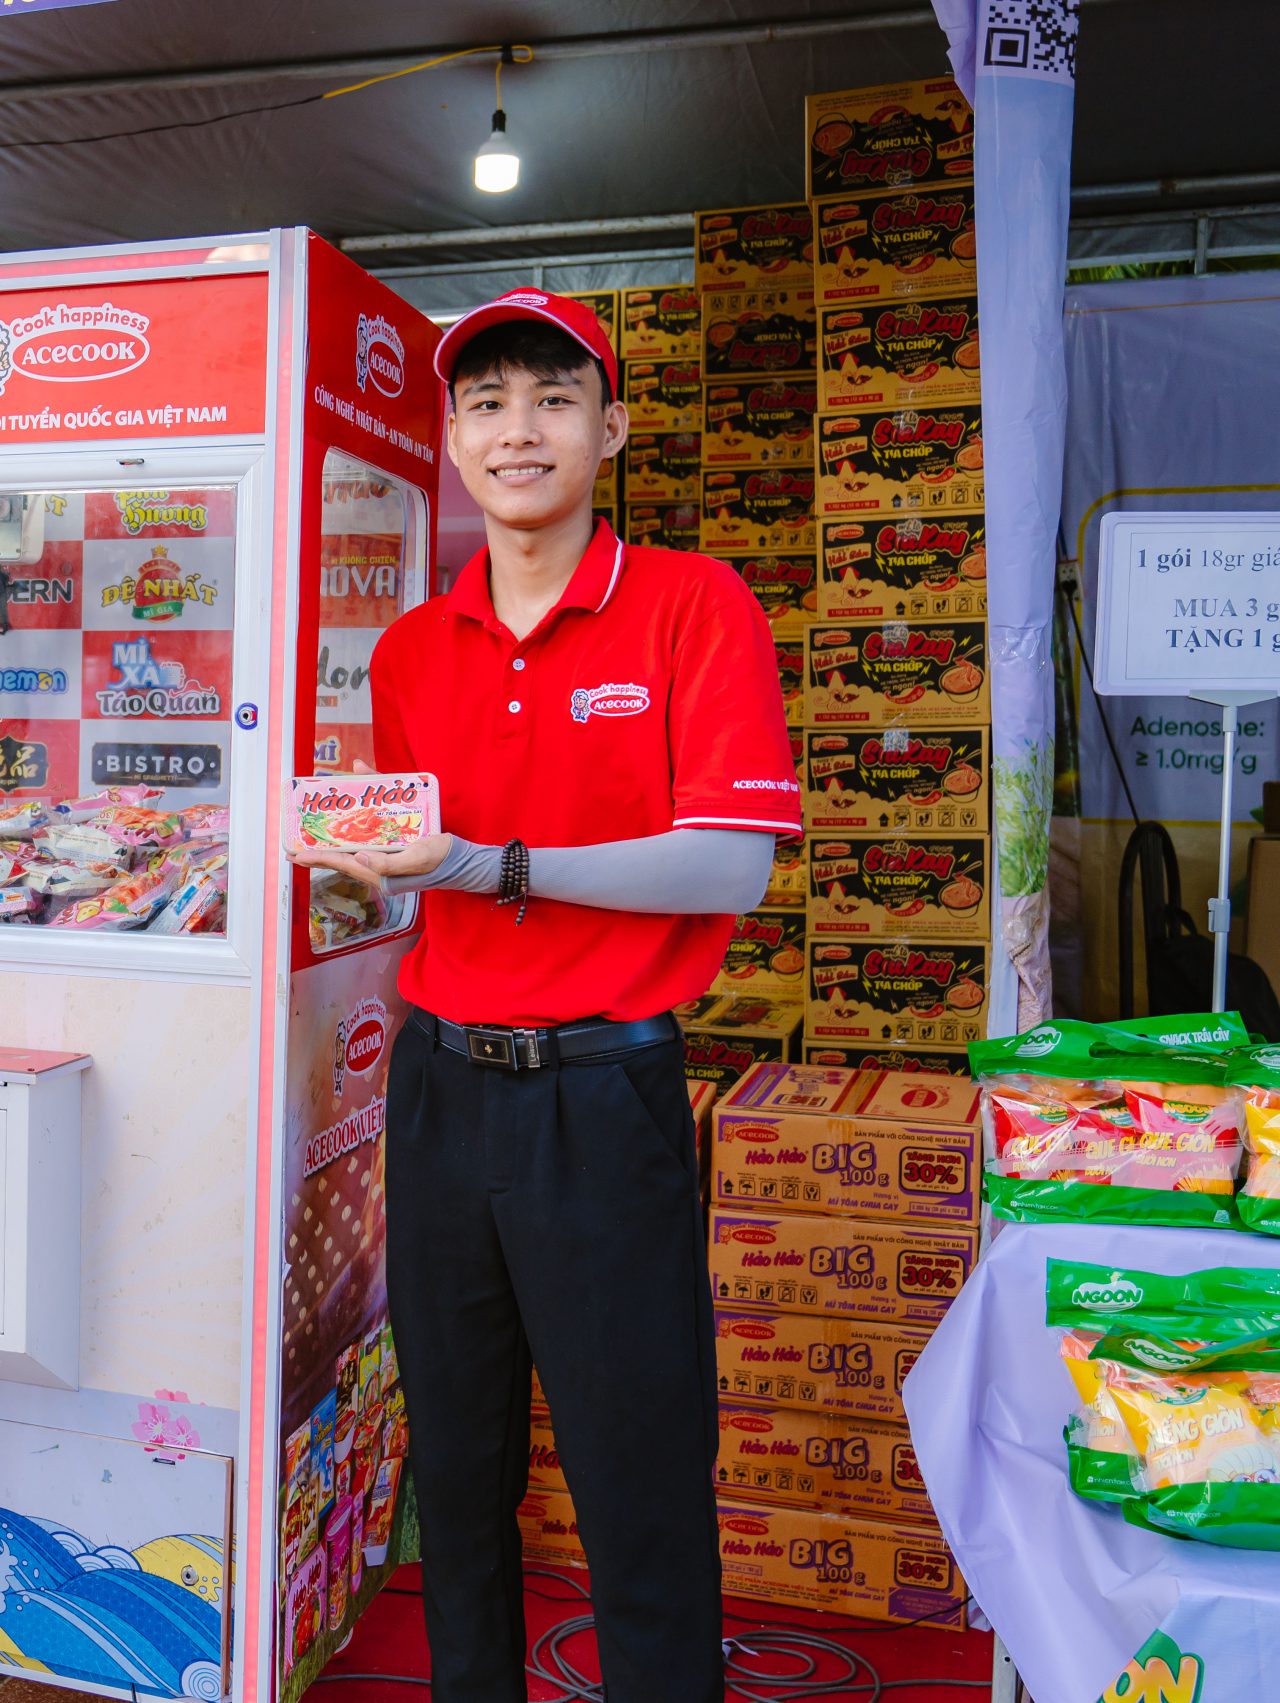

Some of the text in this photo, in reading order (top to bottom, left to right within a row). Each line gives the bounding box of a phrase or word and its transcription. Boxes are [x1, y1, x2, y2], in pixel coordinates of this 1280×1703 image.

[12, 307, 146, 337] Cook happiness
[8, 406, 61, 431] TUYỂN
[63, 404, 112, 430] QUỐC
[114, 410, 144, 426] GIA
[147, 404, 183, 429] VIỆT
[186, 405, 227, 423] NAM
[314, 384, 335, 411] CÔNG
[335, 397, 355, 427] NGHỆ
[356, 408, 373, 433] NHẬT
[398, 432, 413, 454] TOÀN
[414, 443, 423, 457] AN
[422, 443, 434, 464] TÂM
[1138, 548, 1147, 568] 1
[1157, 548, 1191, 573] gói
[1202, 549, 1245, 571] 18gr
[101, 573, 218, 607] ĐỆ NHẤT
[1173, 598, 1238, 618] MUA
[1245, 598, 1258, 617] 3
[1166, 625, 1244, 653] TẶNG
[1253, 629, 1263, 647] 1
[590, 683, 647, 698] Cook happiness
[1131, 716, 1265, 737] Adenosne:
[106, 754, 205, 775] BISTRO
[732, 780, 776, 790] ACECOOK
[302, 779, 417, 814] Hảo Hảo
[1192, 1027, 1212, 1043] TRÁI
[1213, 1026, 1230, 1042] CÂY
[305, 1099, 384, 1173] ACECOOK VIỆT
[814, 1142, 874, 1170] BIG
[840, 1168, 874, 1185] 100
[904, 1163, 958, 1184] 30%
[811, 1247, 871, 1272] BIG
[837, 1272, 871, 1289] 100
[902, 1266, 956, 1289] 30%
[1074, 1289, 1141, 1303] NGOON
[810, 1344, 869, 1370] BIG
[836, 1370, 870, 1387] 100
[833, 1464, 868, 1480] 100
[817, 1566, 851, 1582] 100
[898, 1561, 944, 1582] 30%
